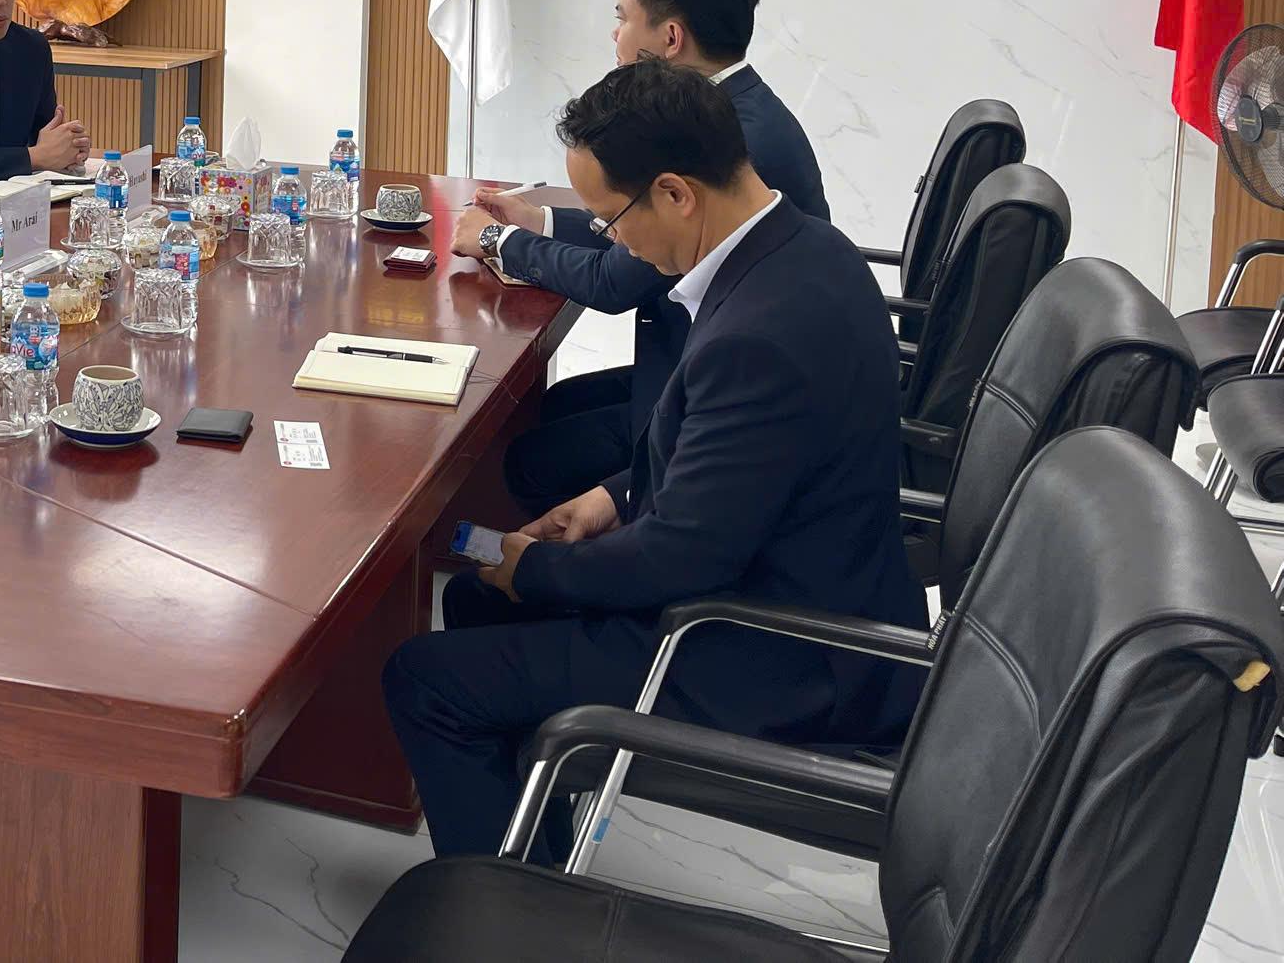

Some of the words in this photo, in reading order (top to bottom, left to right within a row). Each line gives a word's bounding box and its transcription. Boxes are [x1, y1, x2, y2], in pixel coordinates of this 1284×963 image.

[11, 218, 21, 234] Mr
[24, 211, 38, 228] Arai
[11, 343, 35, 357] aVie
